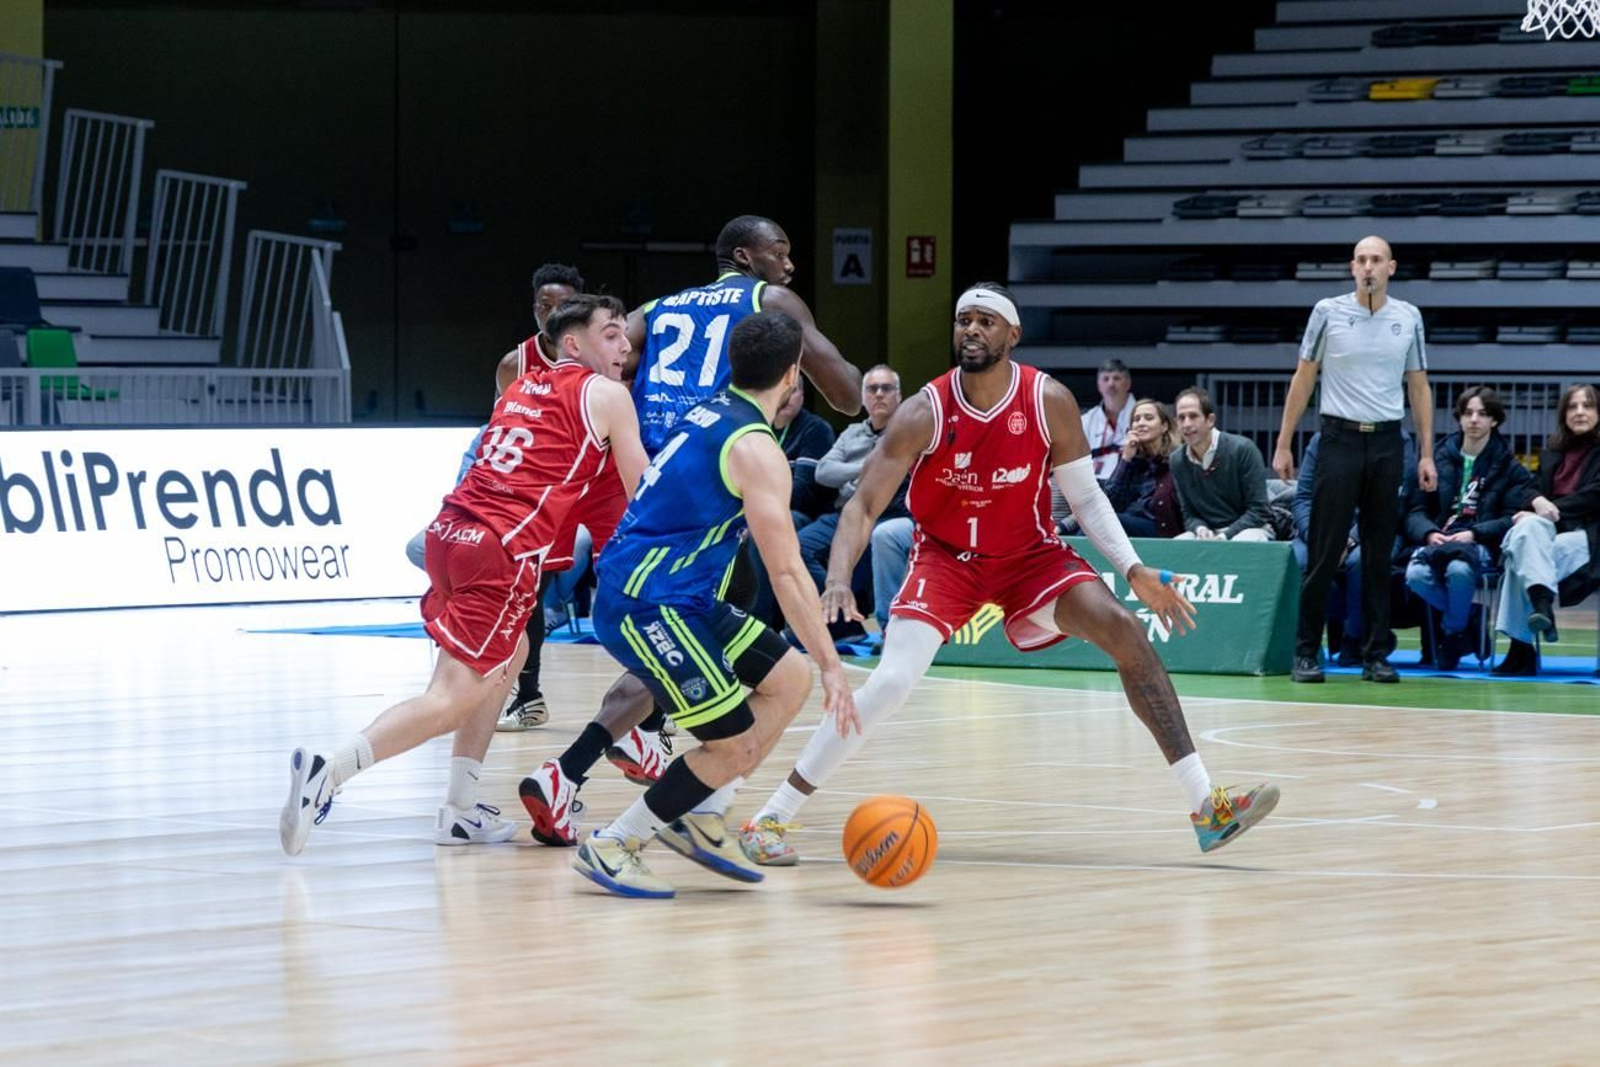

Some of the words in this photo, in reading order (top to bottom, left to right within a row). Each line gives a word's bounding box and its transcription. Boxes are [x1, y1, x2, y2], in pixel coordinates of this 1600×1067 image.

[841, 254, 864, 277] A
[649, 312, 730, 387] 21
[475, 425, 535, 474] 16
[450, 527, 486, 545] ACM
[966, 517, 978, 548] 1
[164, 536, 349, 583] Promowear
[916, 578, 926, 598] 1
